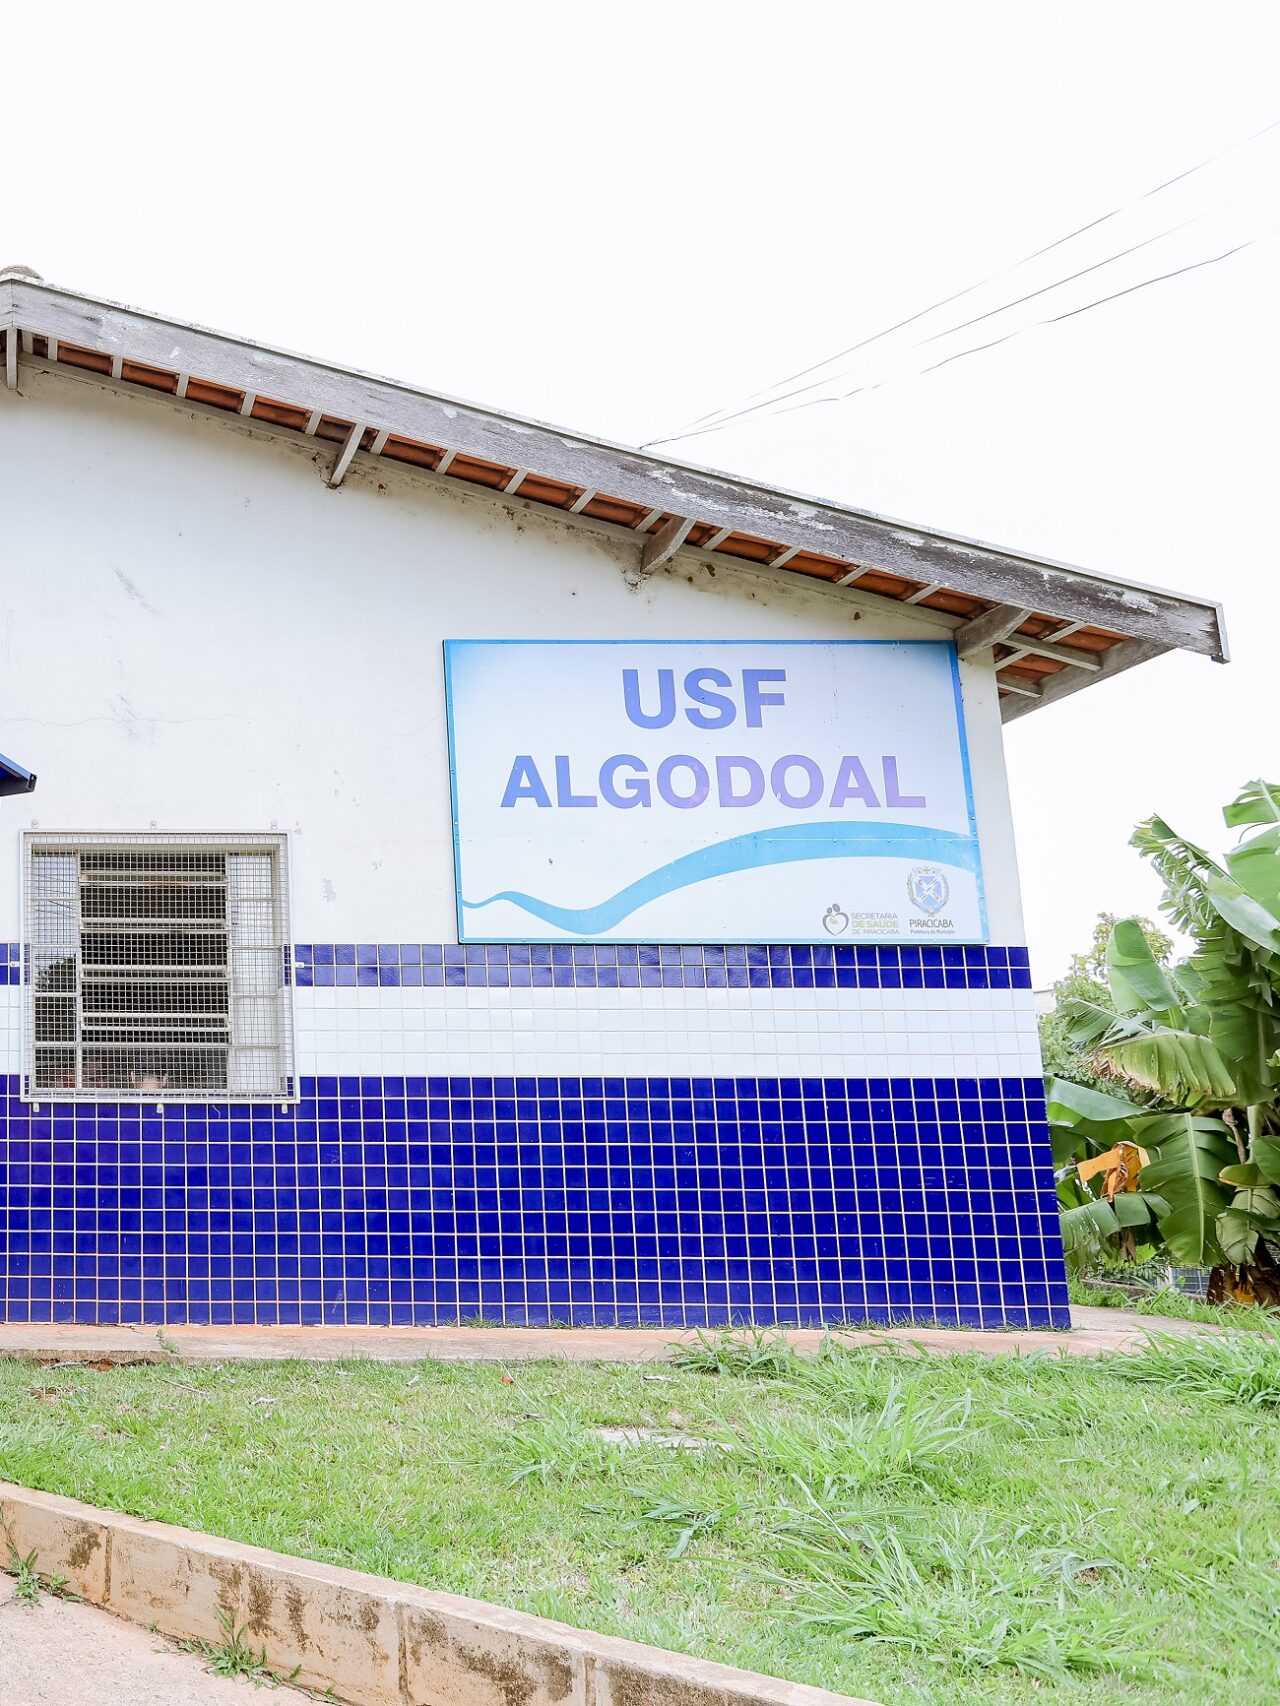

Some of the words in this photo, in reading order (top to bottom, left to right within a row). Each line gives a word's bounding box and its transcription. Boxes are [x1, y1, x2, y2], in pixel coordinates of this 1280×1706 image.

[621, 667, 787, 730] USF
[500, 754, 927, 809] ALGODOAL
[851, 912, 898, 920] SECRETARIA
[852, 920, 865, 928] DE
[909, 918, 954, 928] PIRACICABA
